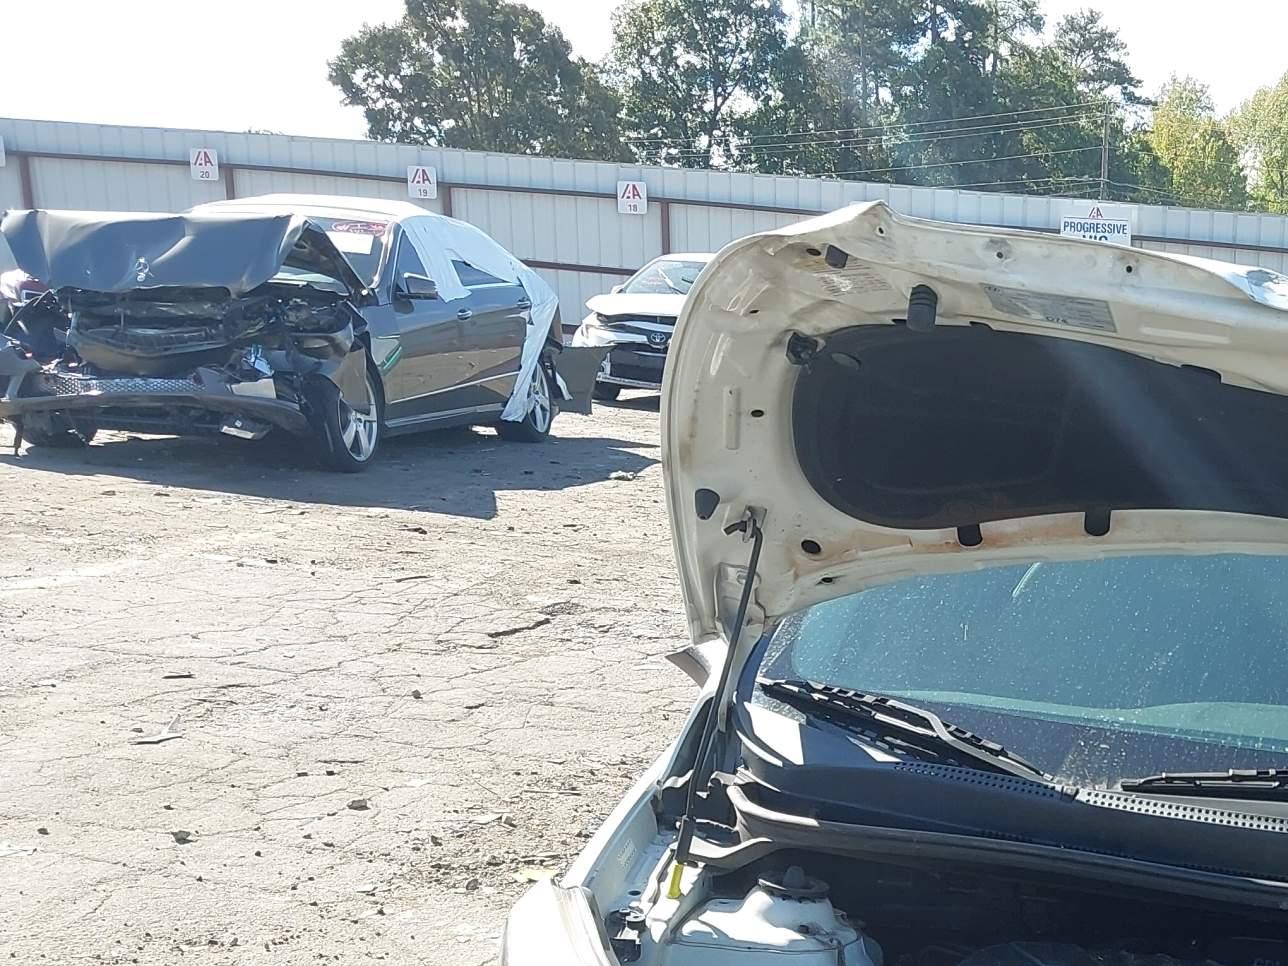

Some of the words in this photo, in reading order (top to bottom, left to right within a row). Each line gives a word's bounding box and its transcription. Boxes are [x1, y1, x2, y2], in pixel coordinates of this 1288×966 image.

[200, 170, 210, 179] 20
[417, 188, 428, 197] 19
[627, 203, 638, 212] 18
[1063, 221, 1128, 235] PROGRESSIVE
